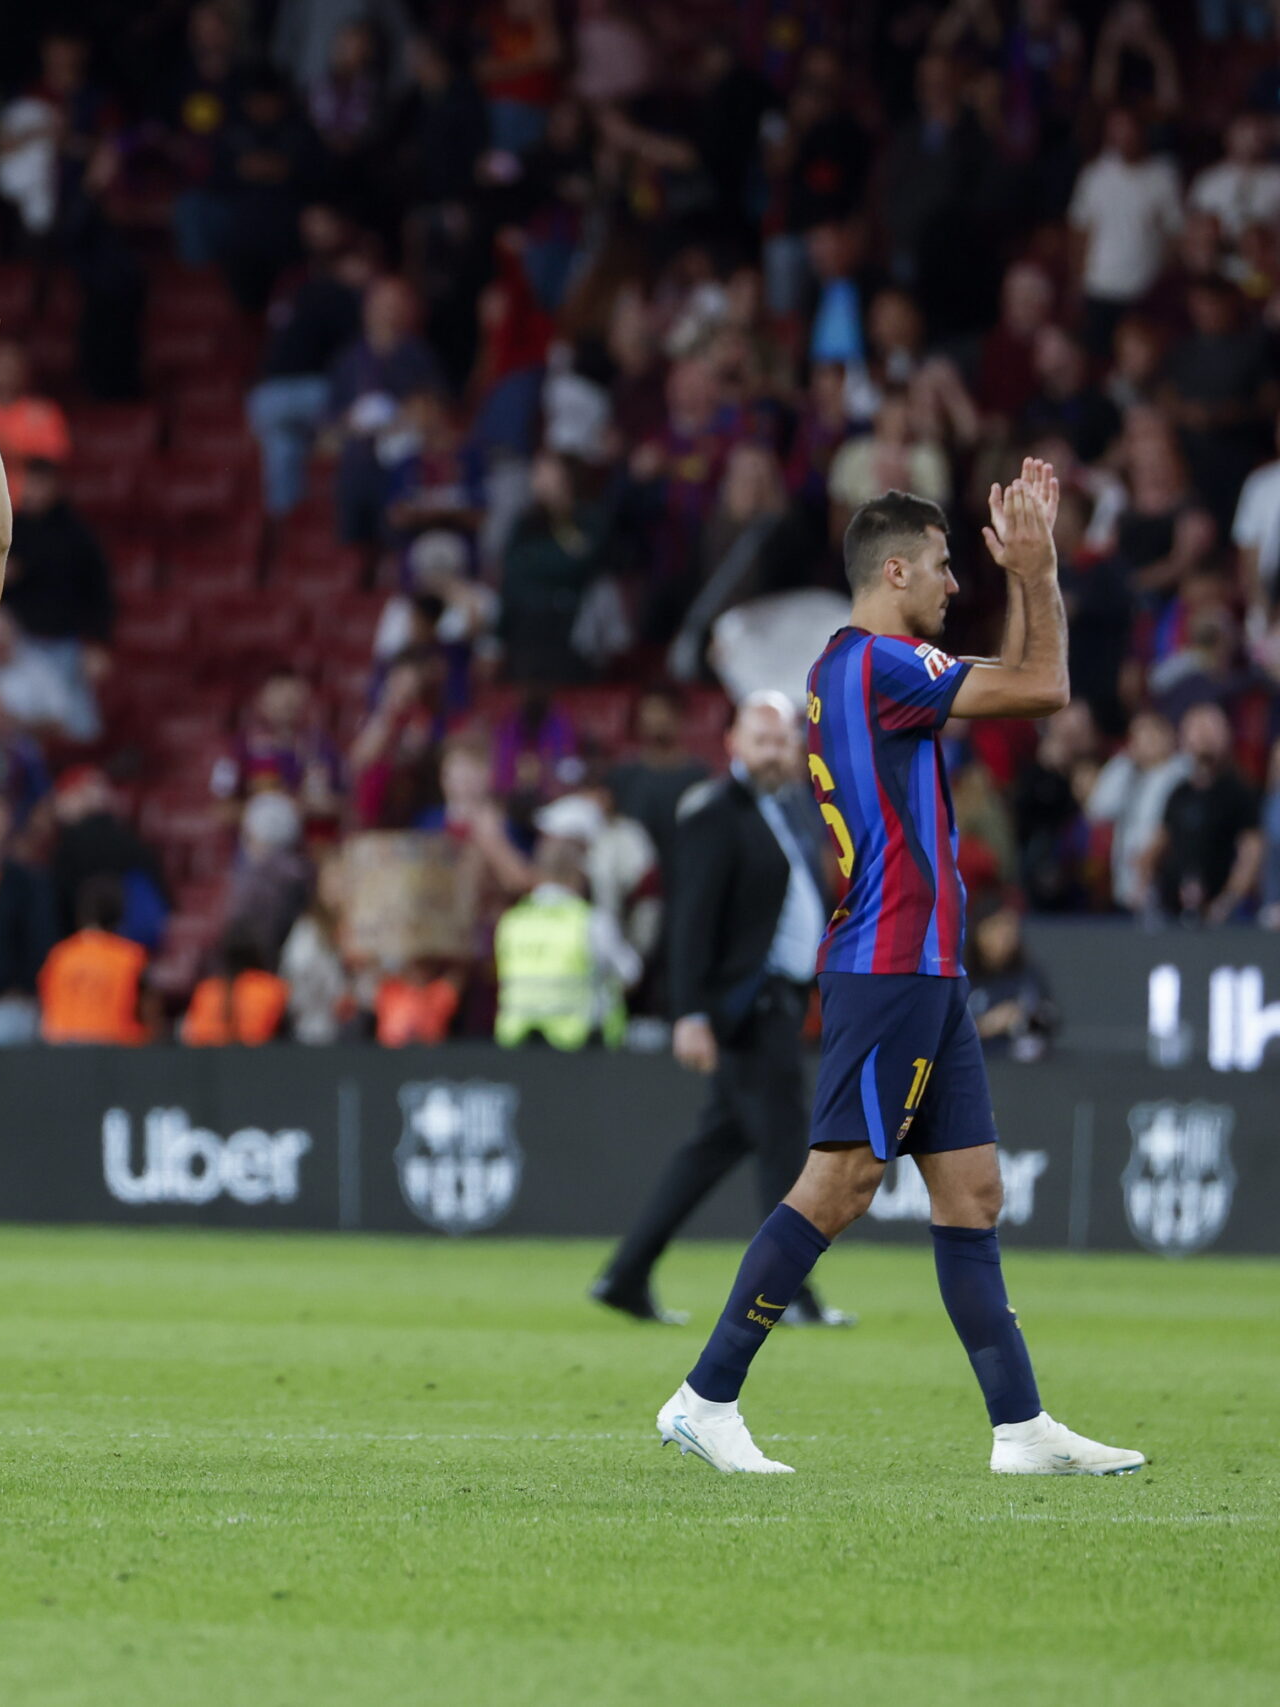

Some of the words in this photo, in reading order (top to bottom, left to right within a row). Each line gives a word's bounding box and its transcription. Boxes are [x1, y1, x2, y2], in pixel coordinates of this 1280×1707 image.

[904, 1058, 934, 1109] 1
[102, 1107, 313, 1204] Uber
[746, 1308, 776, 1330] BARÇ
